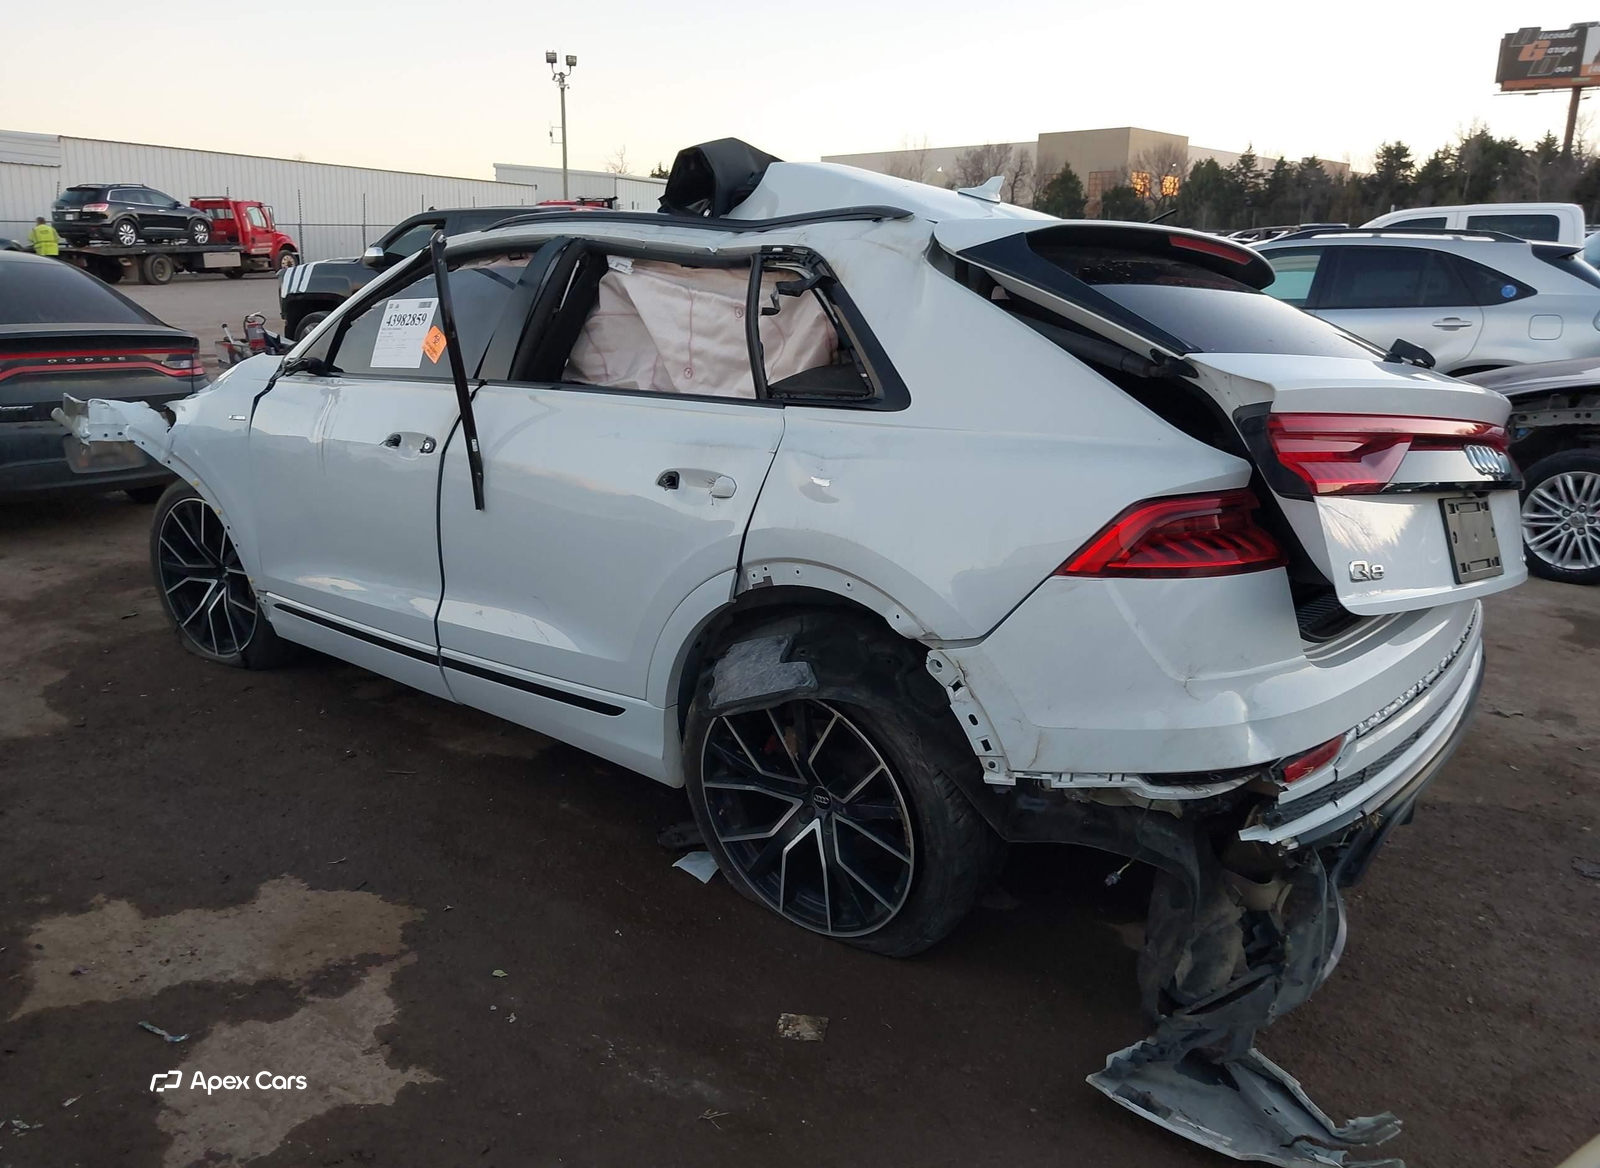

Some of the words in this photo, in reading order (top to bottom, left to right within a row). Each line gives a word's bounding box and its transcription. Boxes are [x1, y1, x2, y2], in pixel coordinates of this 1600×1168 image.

[1517, 40, 1578, 61] Garage
[1527, 55, 1574, 76] Door
[386, 313, 428, 327] 43982859
